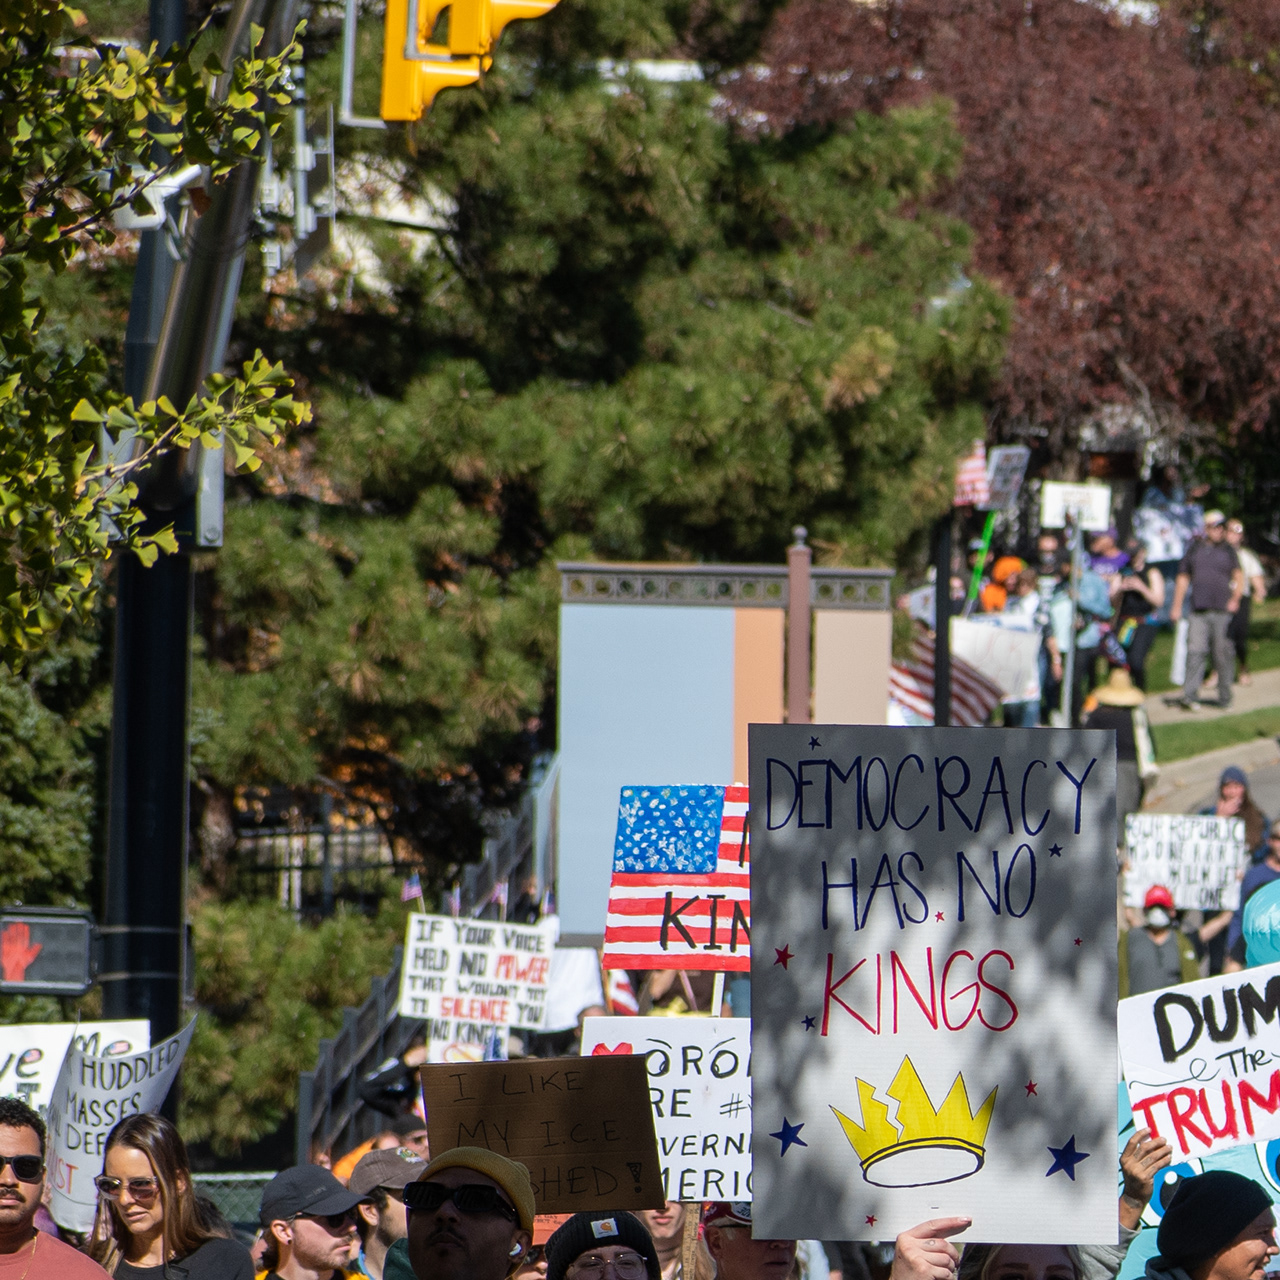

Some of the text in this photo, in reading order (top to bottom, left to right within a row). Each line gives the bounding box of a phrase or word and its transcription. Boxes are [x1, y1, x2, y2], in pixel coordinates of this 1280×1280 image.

[765, 753, 1097, 838] DEMOCRACY
[820, 843, 1036, 932] HAS NO
[415, 919, 546, 953] IF YOUR VOICE
[413, 947, 551, 985] HELD NO POWER
[440, 996, 511, 1023] SILENCE
[516, 1002, 544, 1024] YOU
[820, 946, 1019, 1038] KINGS
[80, 1039, 182, 1092] HUDDLED
[1215, 1046, 1272, 1078] The
[449, 1070, 584, 1103] I LIKE
[65, 1091, 142, 1128] MASSES
[456, 1118, 511, 1153] MY
